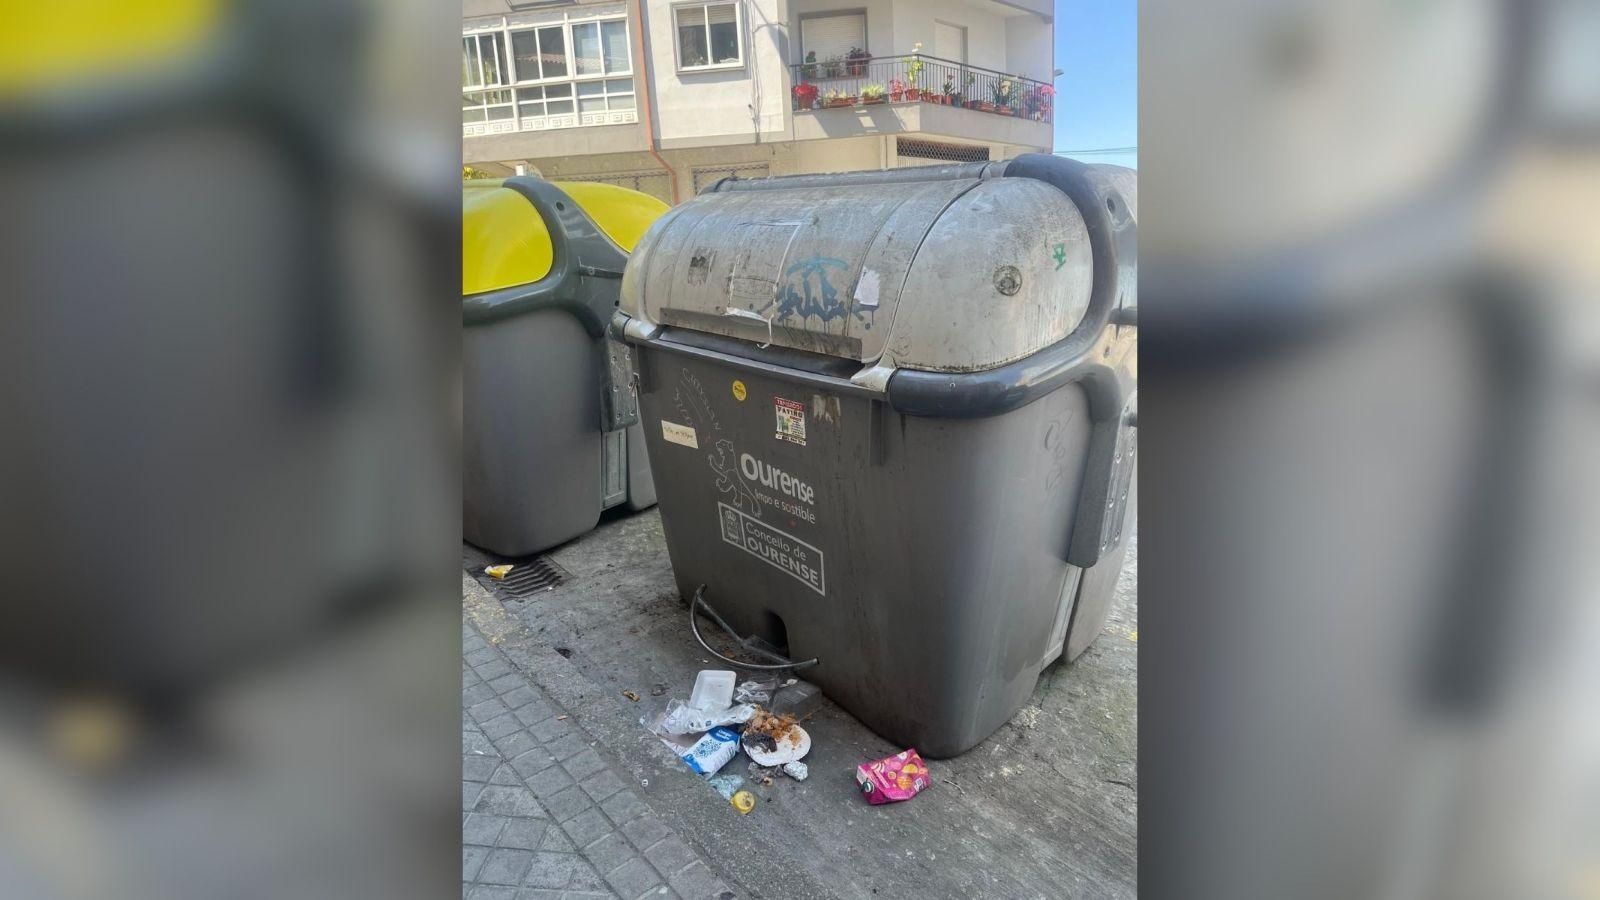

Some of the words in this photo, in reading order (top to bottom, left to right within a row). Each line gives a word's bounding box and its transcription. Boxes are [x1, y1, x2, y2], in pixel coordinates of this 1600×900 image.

[741, 453, 814, 505] Ourense
[774, 499, 780, 509] e
[782, 501, 816, 525] sostible
[746, 522, 790, 552] Concello
[793, 546, 807, 561] de
[747, 537, 819, 586] OURENSE
